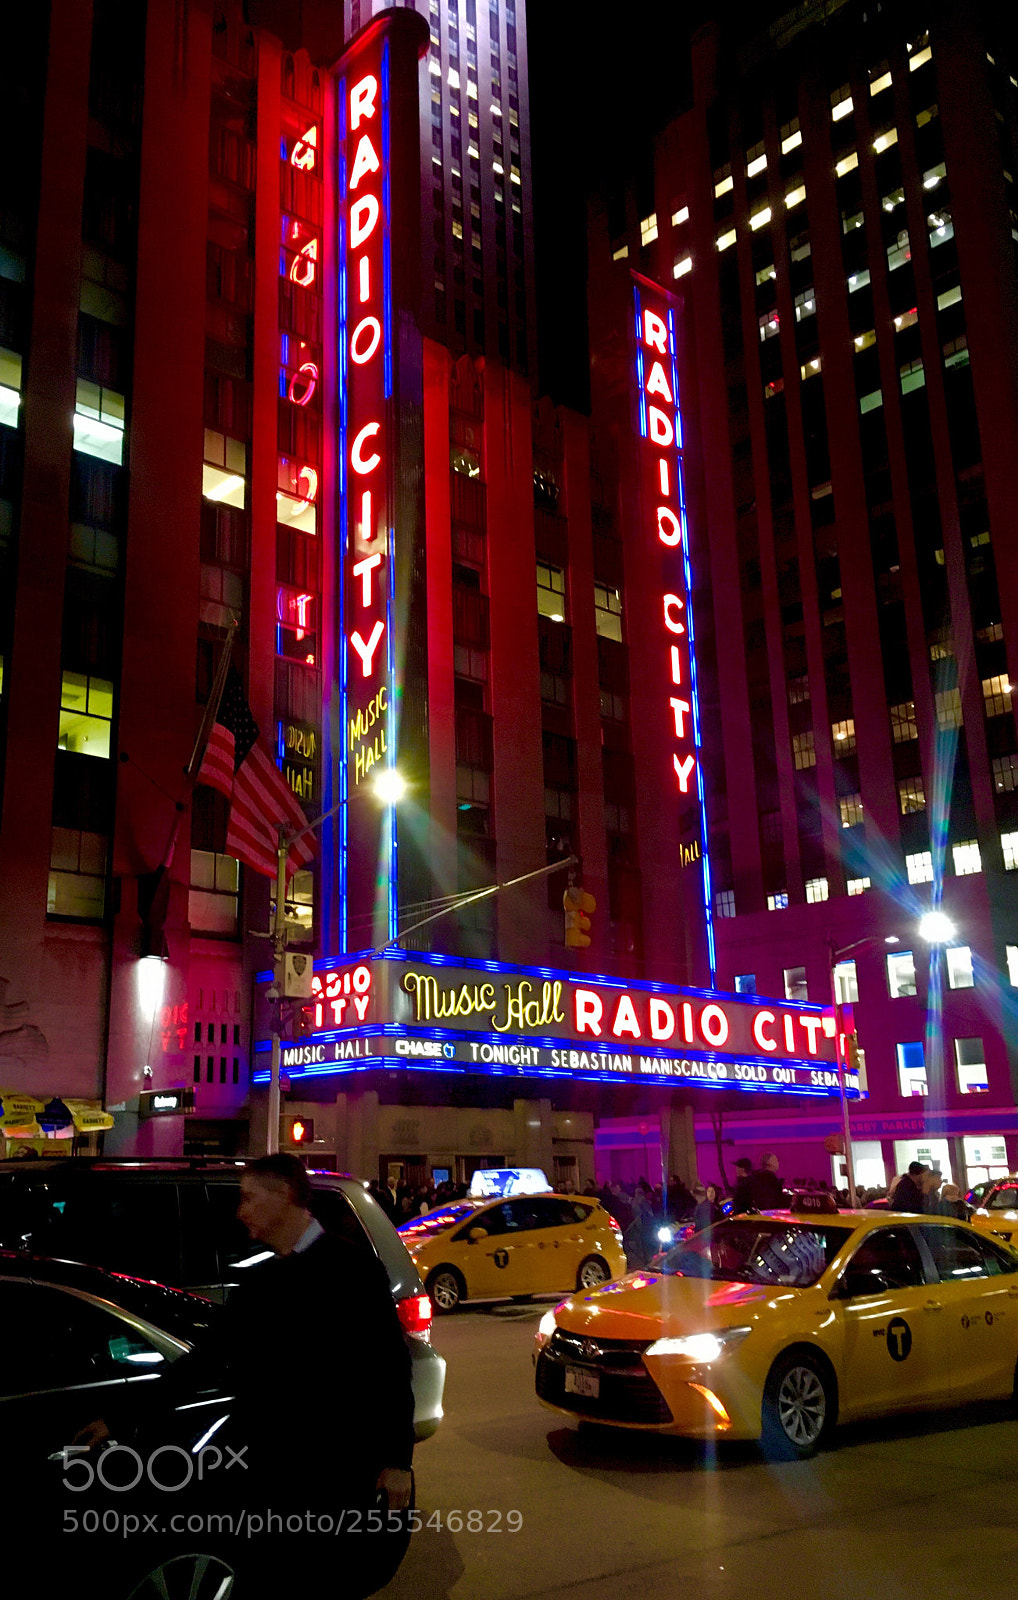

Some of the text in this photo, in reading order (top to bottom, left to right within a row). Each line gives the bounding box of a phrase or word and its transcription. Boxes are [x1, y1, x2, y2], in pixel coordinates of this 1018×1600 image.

[349, 74, 385, 679] RADIO CITY
[644, 309, 696, 793] RADIO CITY
[350, 686, 388, 751] MUSIC
[354, 728, 388, 785] HALL
[311, 965, 372, 999] ADIO
[300, 994, 371, 1028] ITY
[403, 972, 497, 1021] Music
[491, 980, 565, 1032] Hall
[574, 988, 729, 1047] RADIO
[283, 1038, 373, 1067] MUSIC HALL
[394, 1039, 443, 1057] CHASE
[469, 1042, 540, 1066] TONIGHT
[550, 1049, 633, 1073] SEBASTIAN
[639, 1056, 728, 1080] MANISCALCO
[734, 1064, 768, 1082] SOLD
[772, 1068, 796, 1084] OUT
[881, 1119, 926, 1131] PARKER
